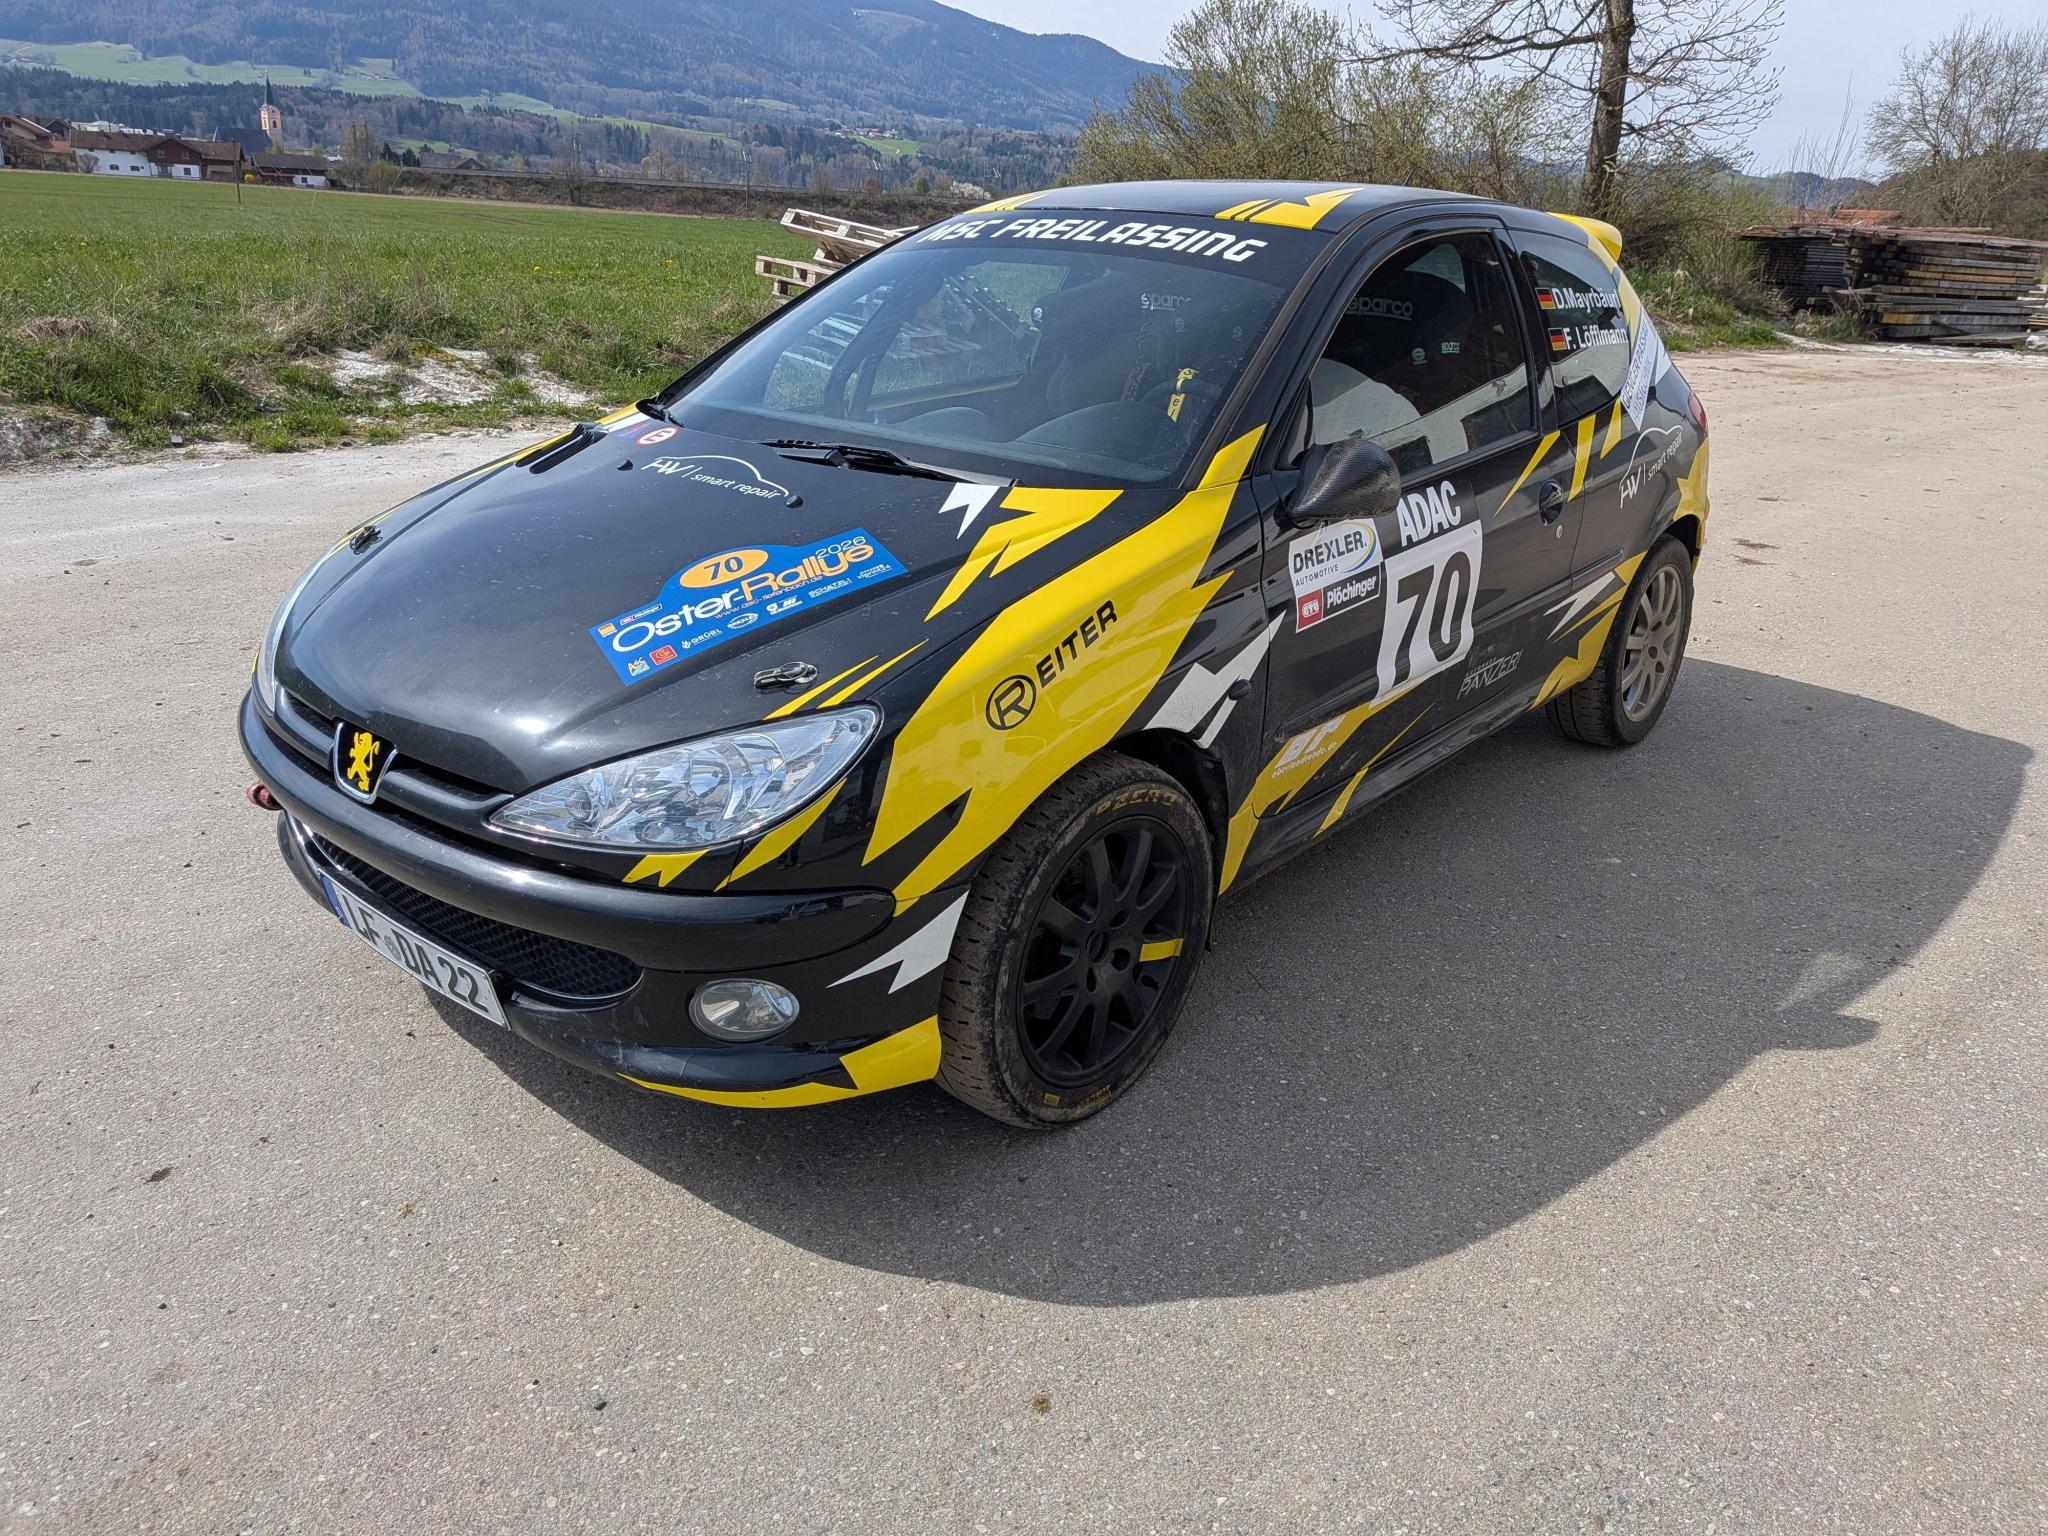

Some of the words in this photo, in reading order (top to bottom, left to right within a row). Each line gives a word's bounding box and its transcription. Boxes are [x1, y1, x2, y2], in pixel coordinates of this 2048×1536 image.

[916, 219, 1004, 243] MSC
[989, 218, 1269, 262] FREILASSING
[1575, 324, 1629, 349] Löfflmann
[1647, 452, 1667, 481] smart
[1666, 431, 1684, 461] repair
[690, 473, 737, 490] smart
[732, 483, 782, 499] repair
[1396, 480, 1462, 548] ADAC
[703, 556, 744, 581] 70
[815, 536, 867, 560] 2026
[1293, 530, 1365, 574] DREXLER
[1295, 563, 1339, 587] AUTOMOTIVE
[1326, 575, 1377, 609] Plöchinger
[612, 545, 874, 653] Oster-Rallye
[1392, 551, 1471, 688] 70
[1457, 651, 1520, 700] PANZER
[341, 894, 381, 948] LF
[390, 928, 444, 989] DA
[437, 955, 489, 1013] 22
